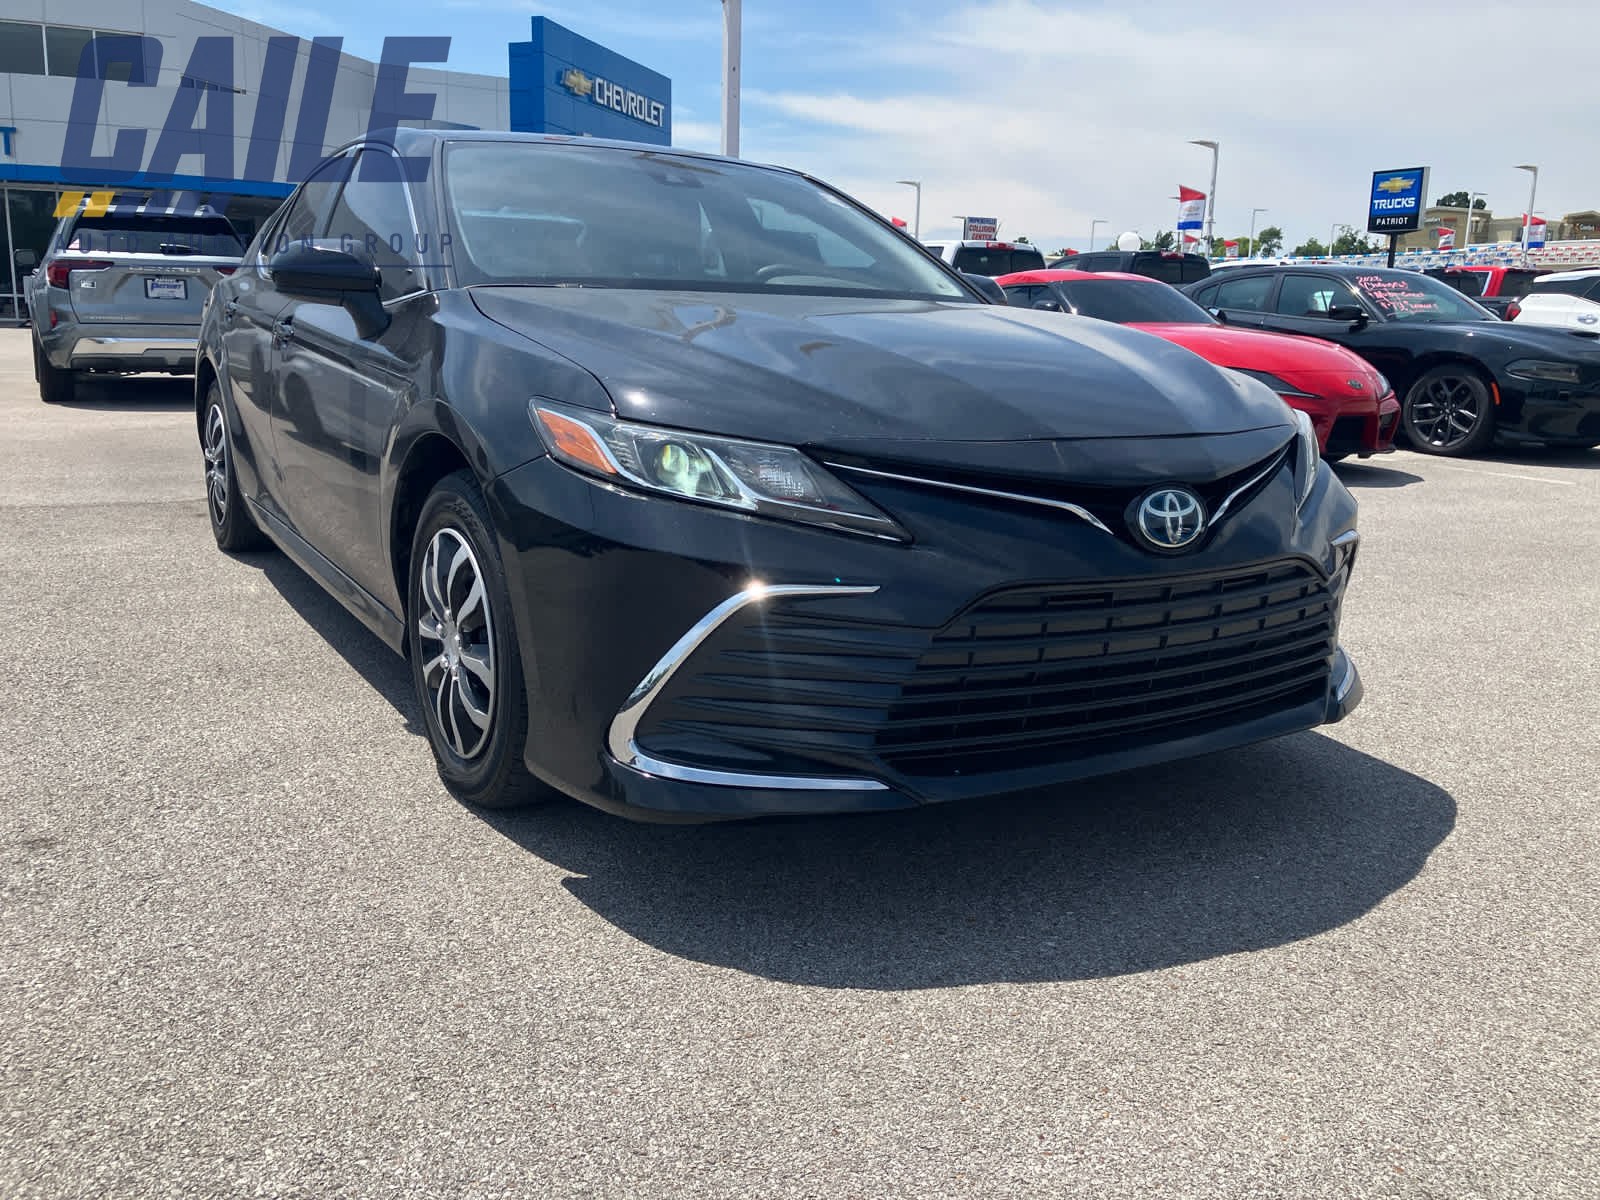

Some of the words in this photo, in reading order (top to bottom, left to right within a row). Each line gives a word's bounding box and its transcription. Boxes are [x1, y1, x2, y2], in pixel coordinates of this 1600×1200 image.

[595, 77, 664, 127] CHEVROLET
[1373, 197, 1416, 210] TRUCKS
[1376, 217, 1408, 225] PATRIOT
